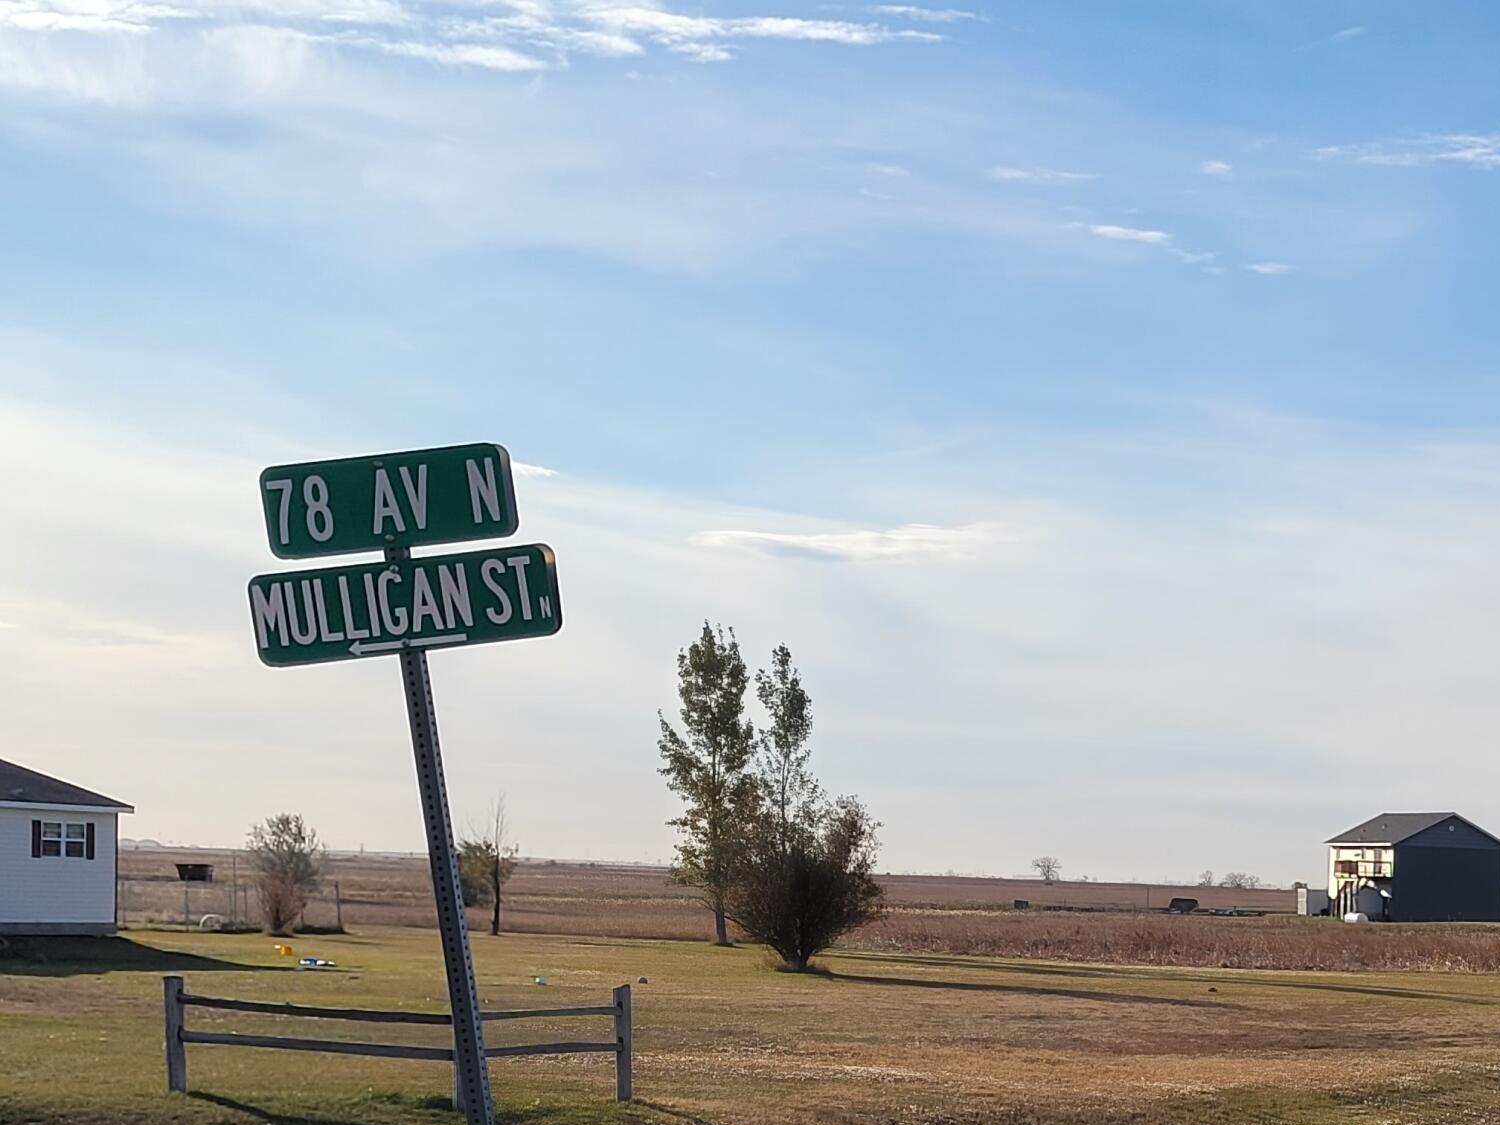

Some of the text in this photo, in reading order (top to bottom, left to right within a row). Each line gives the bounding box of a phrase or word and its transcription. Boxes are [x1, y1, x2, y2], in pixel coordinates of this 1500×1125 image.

[266, 457, 501, 545] 78 AV N
[251, 555, 552, 649] MULLIGAN ST N
